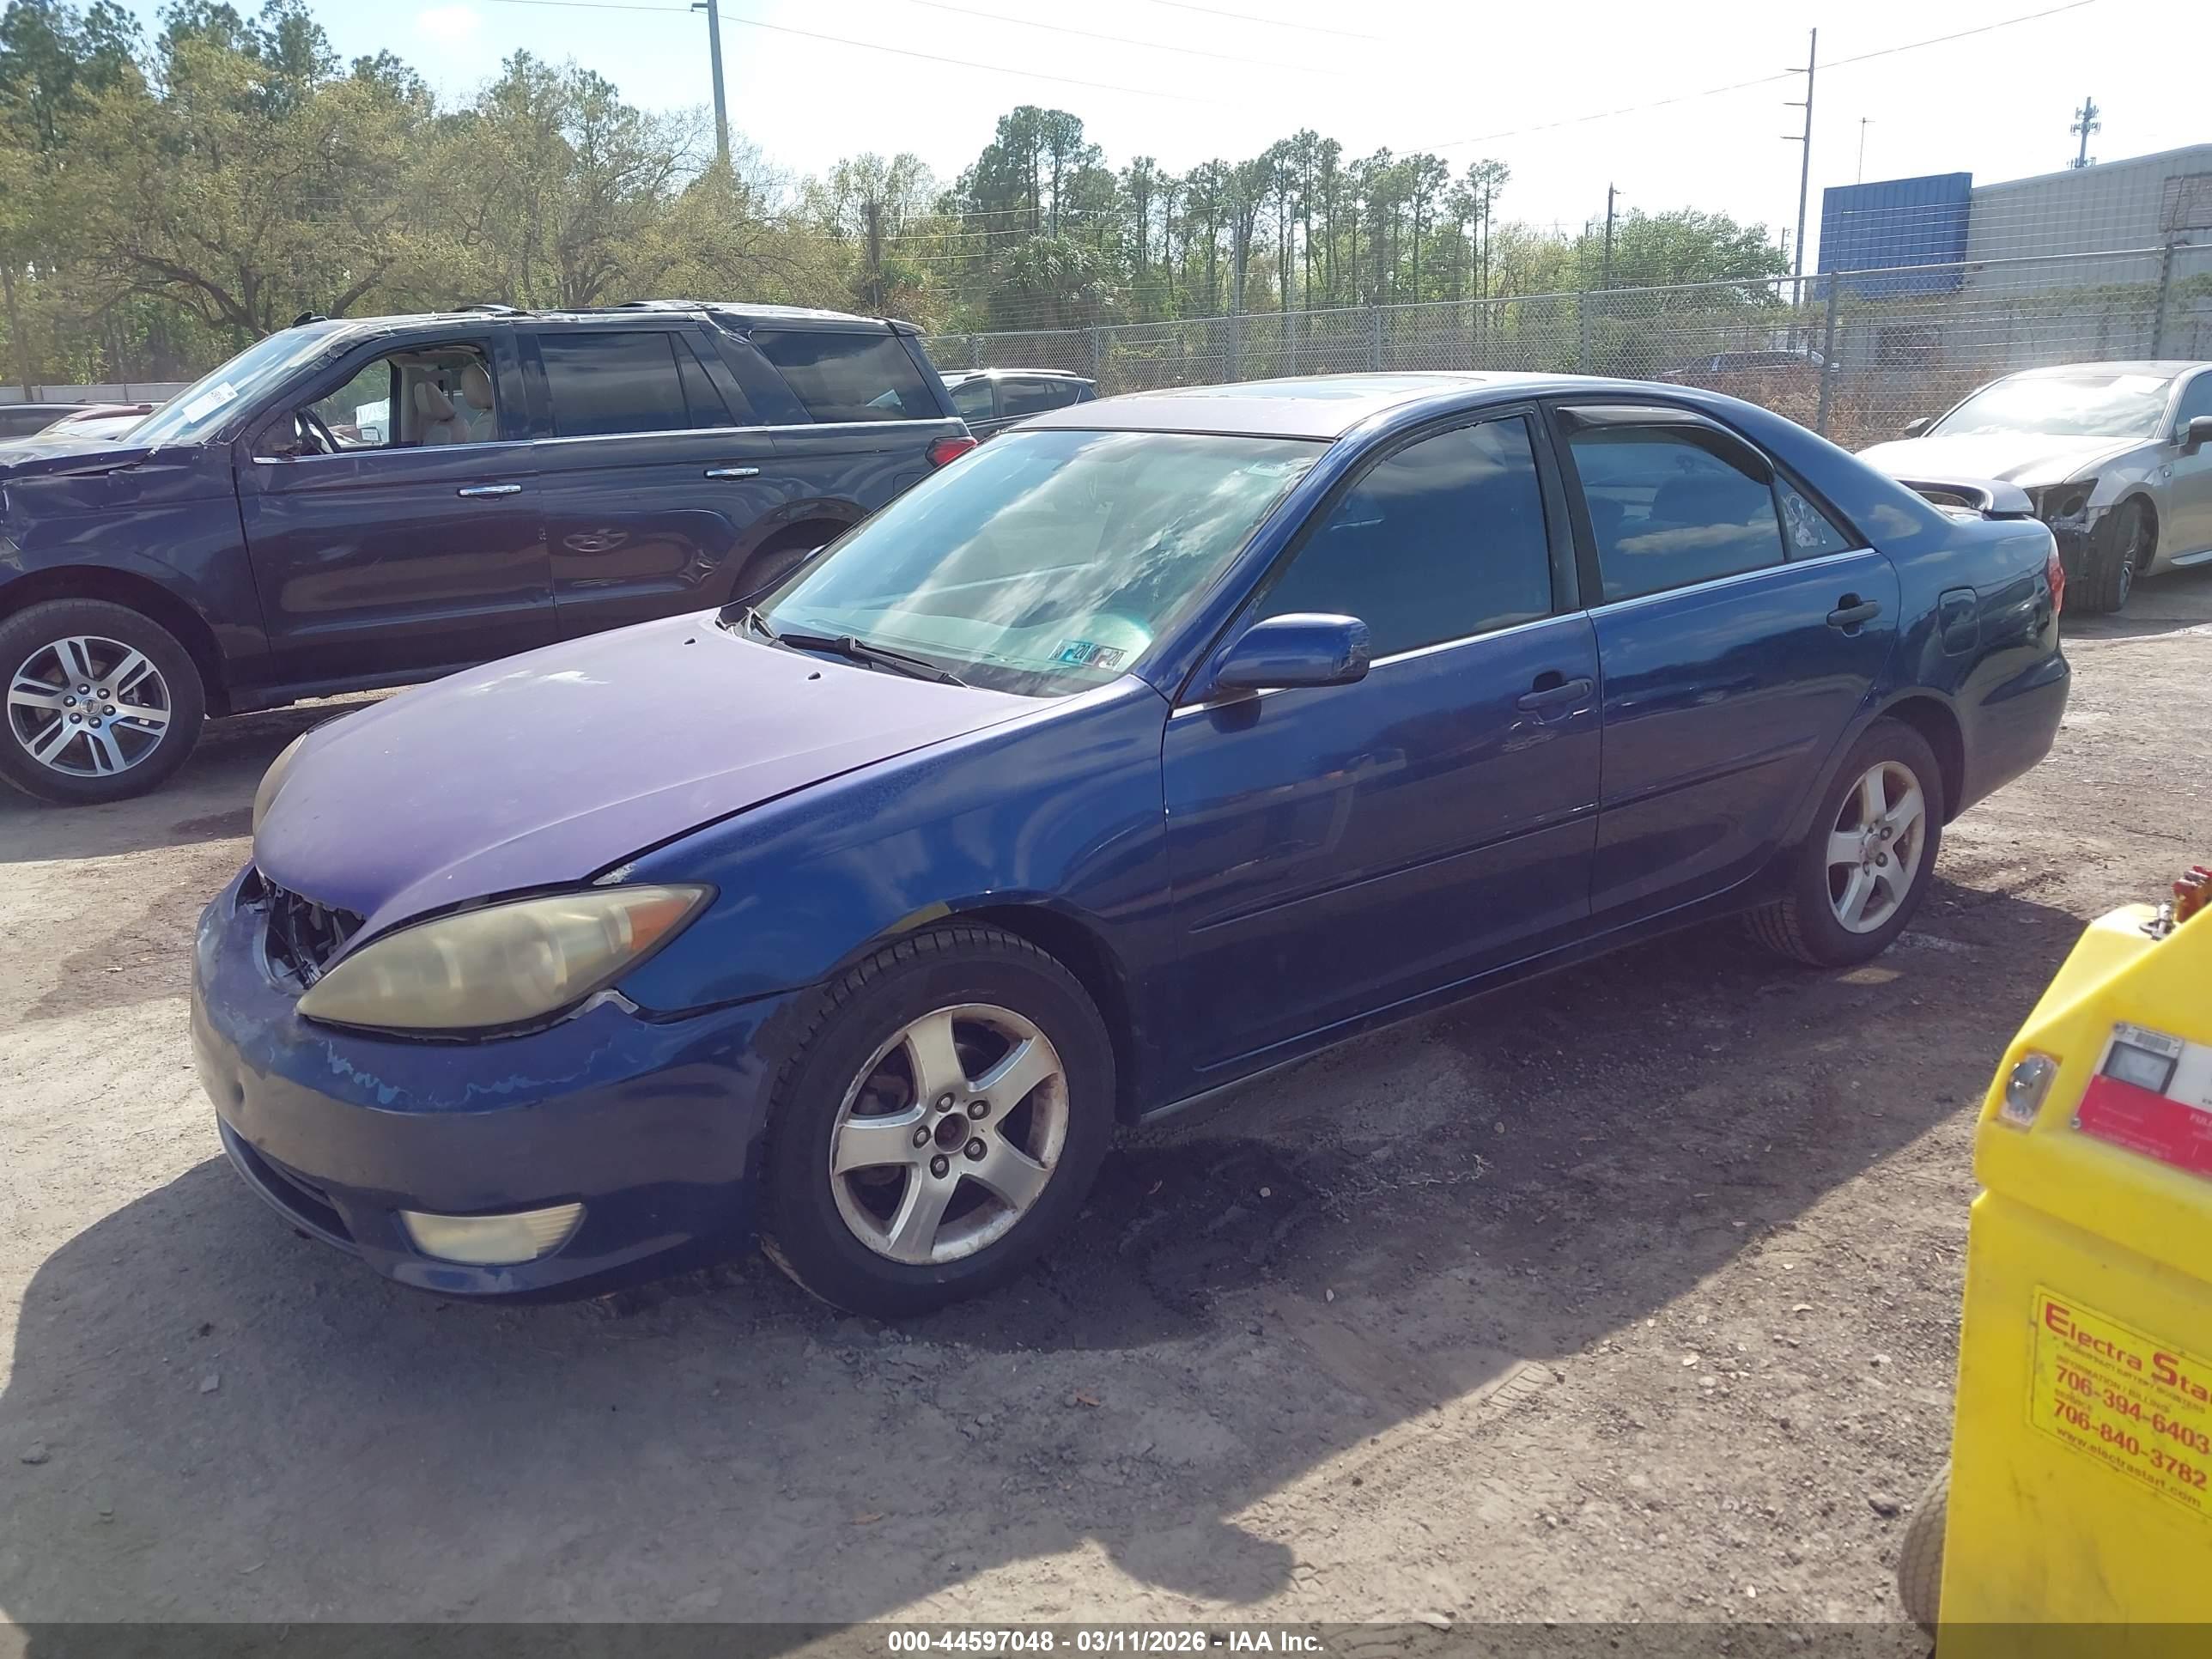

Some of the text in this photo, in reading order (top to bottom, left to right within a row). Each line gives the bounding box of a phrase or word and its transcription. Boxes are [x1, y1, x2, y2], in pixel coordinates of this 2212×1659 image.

[2045, 1301, 2212, 1405] Electra Sta
[2053, 1397, 2208, 1492] 706-840-3782
[2056, 1364, 2210, 1455] 706-394-6403
[2056, 1427, 2202, 1508] www.electrastart.com
